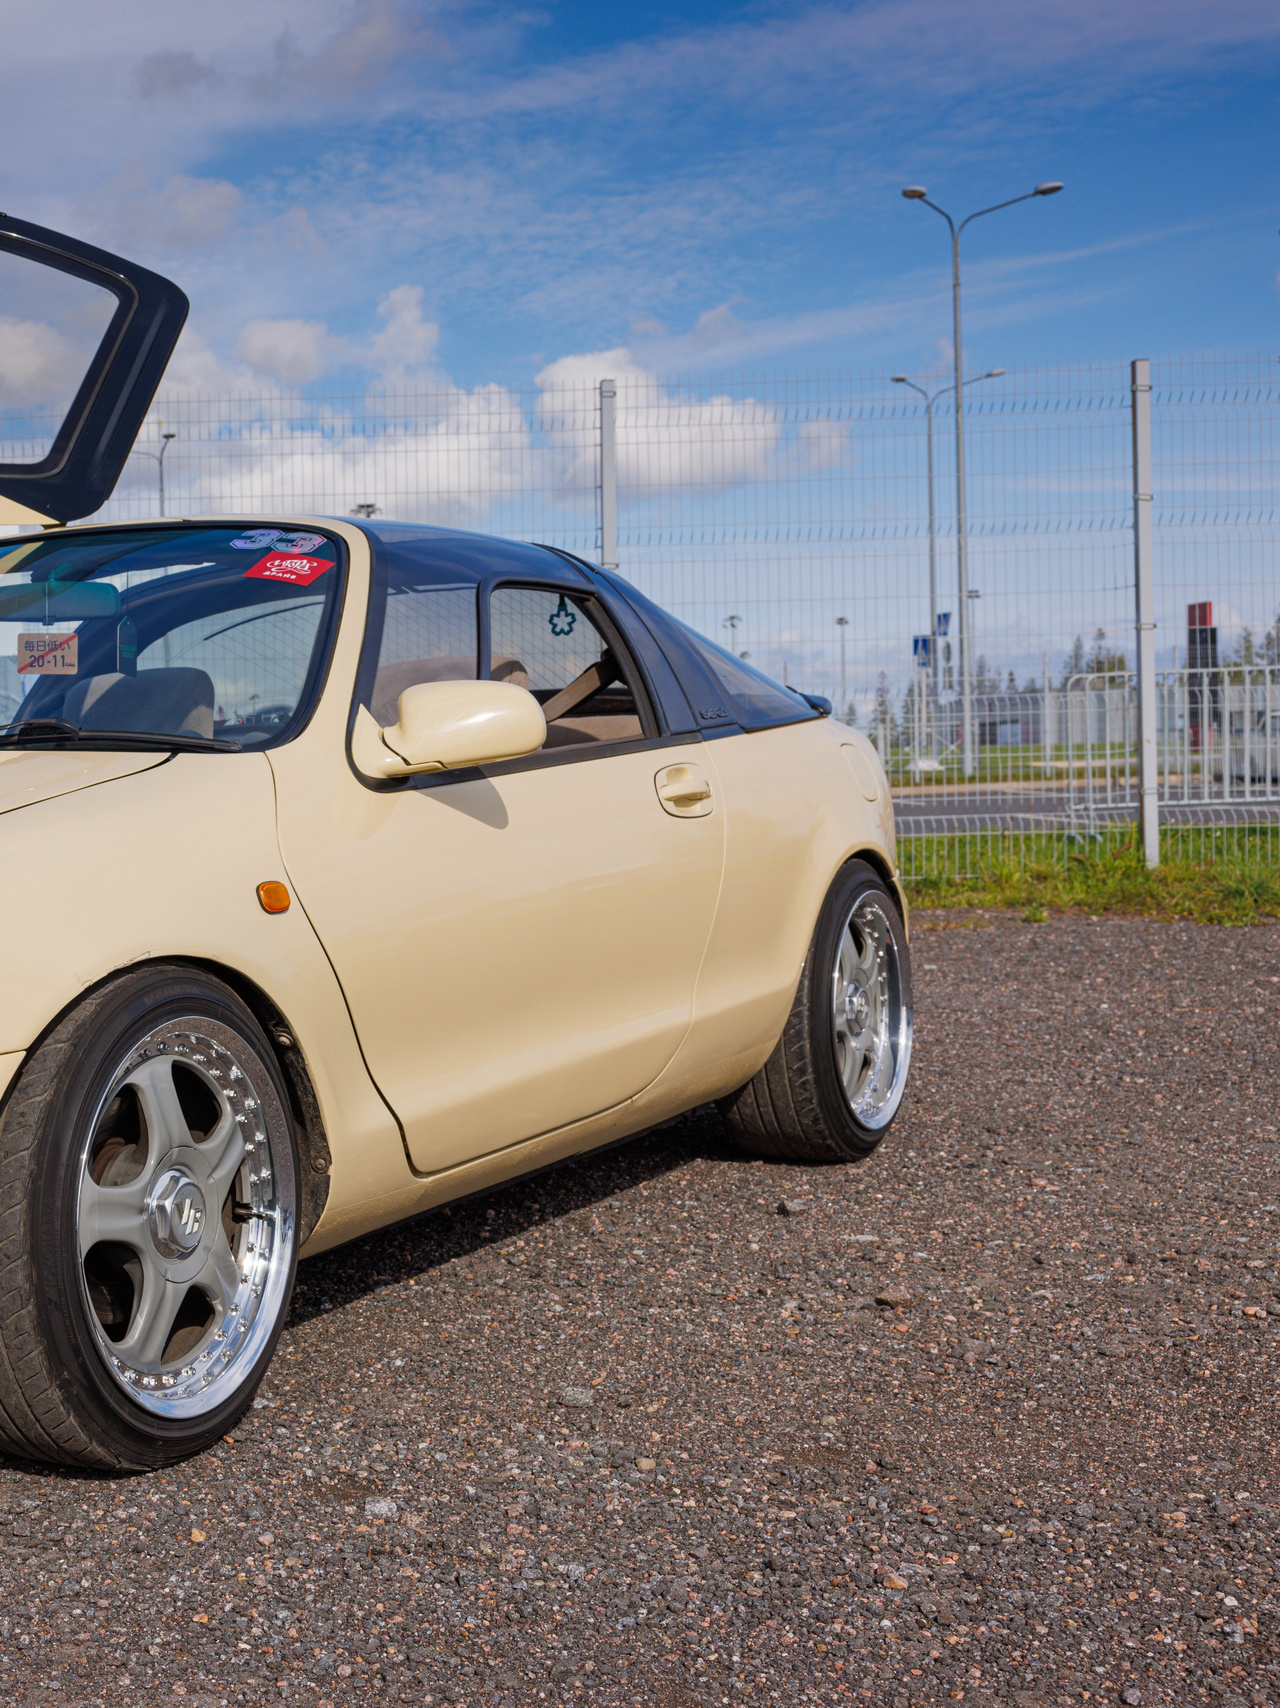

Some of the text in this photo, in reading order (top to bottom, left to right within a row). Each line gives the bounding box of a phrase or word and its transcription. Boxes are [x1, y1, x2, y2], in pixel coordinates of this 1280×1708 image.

[229, 528, 327, 554] 33
[24, 640, 71, 652] 毎日低い
[699, 707, 729, 720] SERA
[41, 1197, 56, 1292] YOKOHAMA
